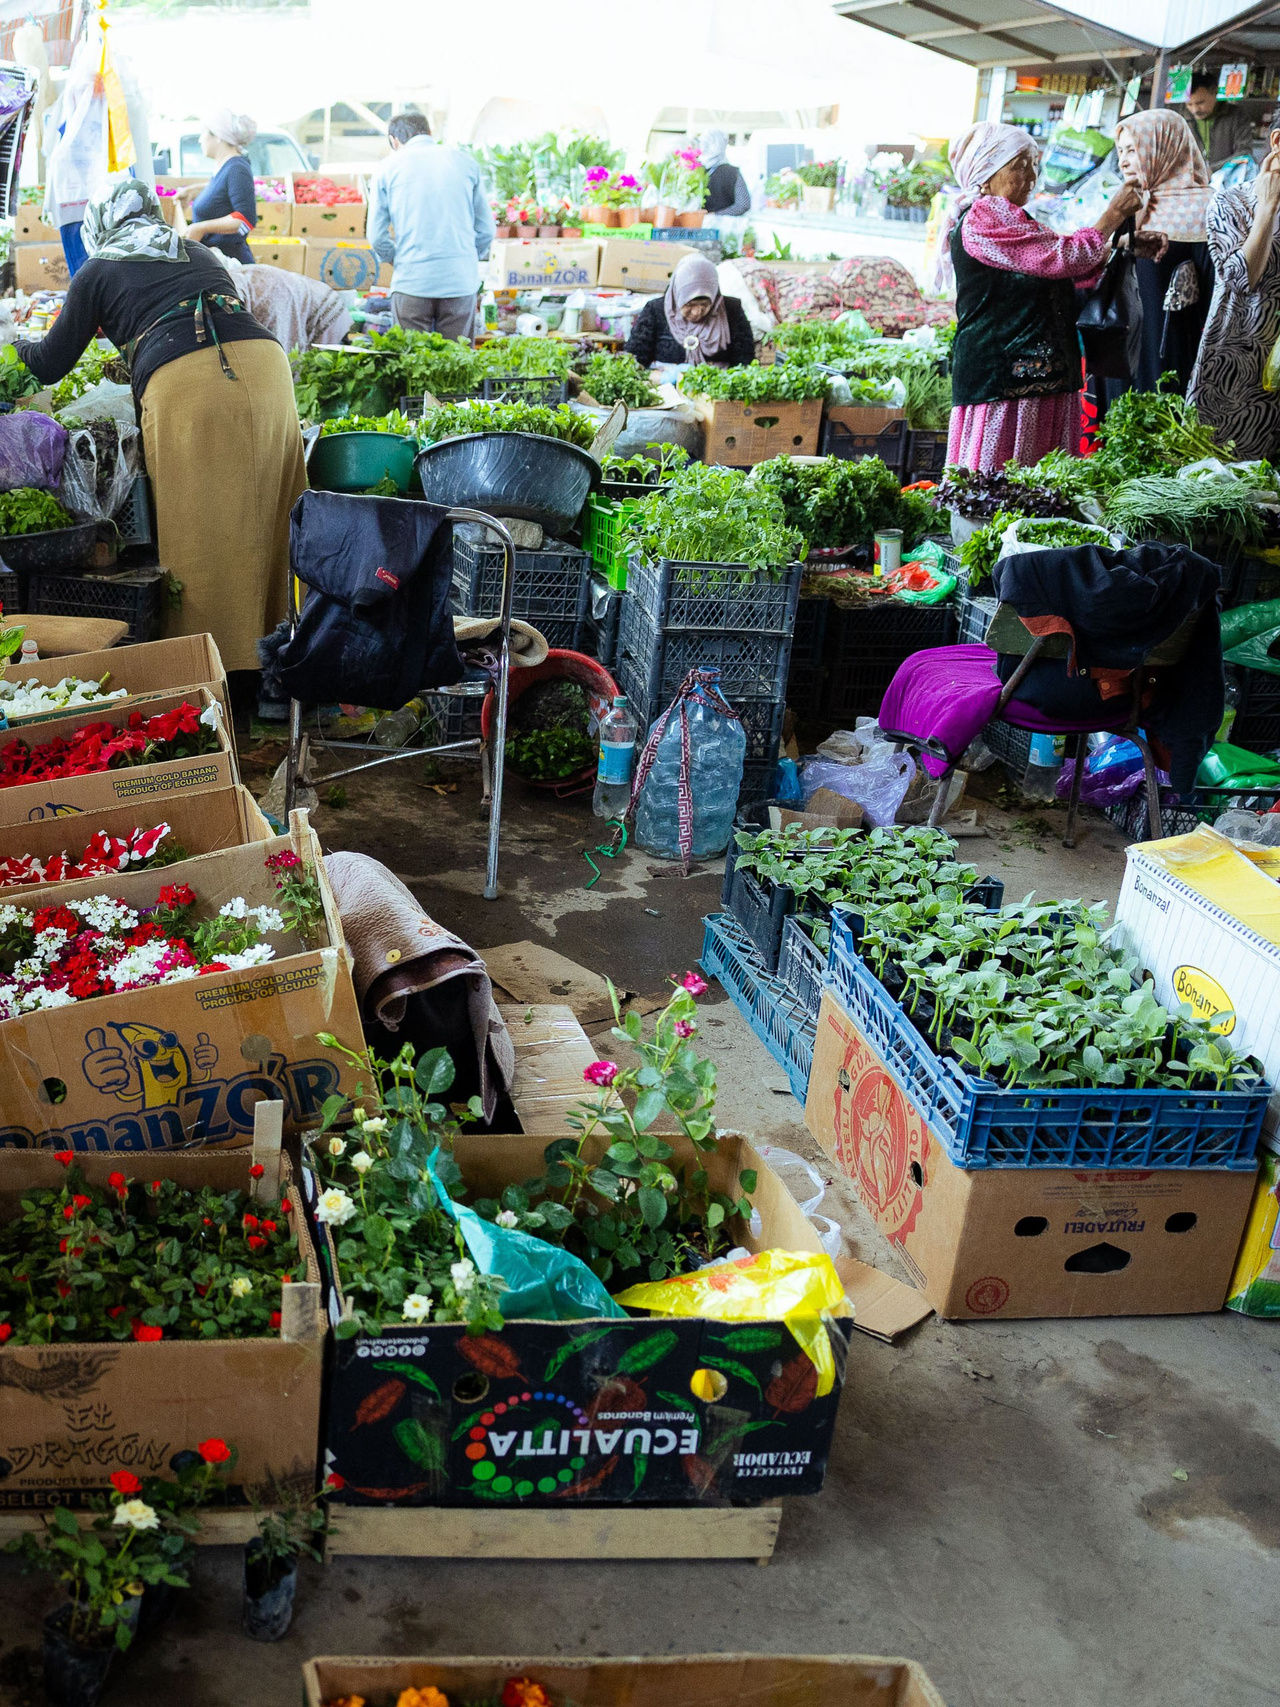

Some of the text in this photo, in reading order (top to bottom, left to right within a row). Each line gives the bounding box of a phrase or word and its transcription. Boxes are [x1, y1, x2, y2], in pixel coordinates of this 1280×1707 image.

[113, 765, 218, 790] PREMIUM GOLD BANANA
[118, 774, 217, 798] PRODUCT OF ECUADOR
[1134, 875, 1170, 914] Bonanza!
[195, 981, 250, 1001] PREMIUM
[252, 974, 285, 990] GOLD
[202, 974, 327, 1010] PRODUCT OF ECUADO
[1177, 970, 1229, 1031] Bonanz!
[893, 1129, 919, 1224] QULITY
[1063, 1220, 1146, 1234] FRUTADELI
[597, 1410, 695, 1423] Premium Bananas
[488, 1428, 699, 1457] ECUALITTA
[732, 1450, 812, 1467] ECUADOR
[736, 1466, 803, 1476] PRODUCT OF
[20, 1477, 78, 1487] PRODUCT
[80, 1477, 98, 1486] OF
